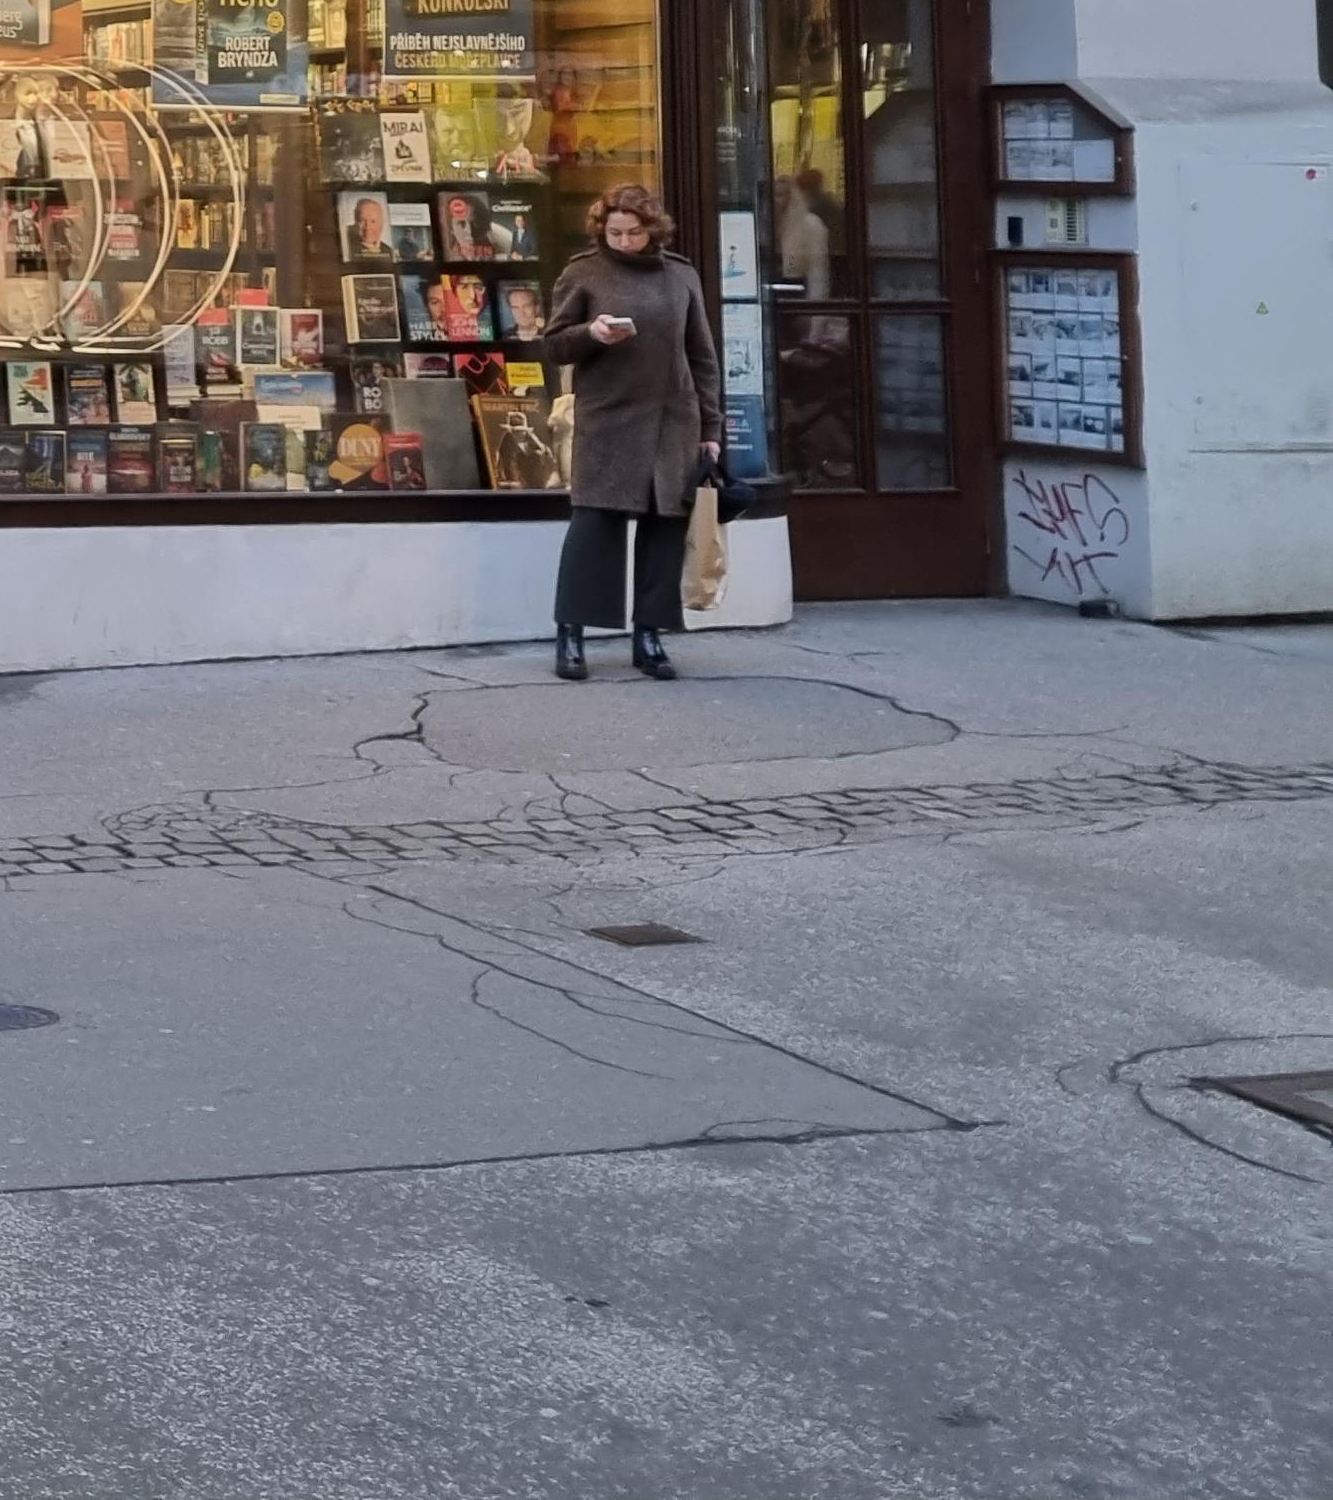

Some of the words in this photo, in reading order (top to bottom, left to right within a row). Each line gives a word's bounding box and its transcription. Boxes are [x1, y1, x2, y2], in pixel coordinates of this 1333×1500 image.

[225, 36, 271, 51] ROBERT
[390, 32, 431, 51] PŘÍBĚH
[433, 32, 526, 52] NEJSLAVNĚJŠÍHO
[217, 50, 278, 68] BRYNDZA
